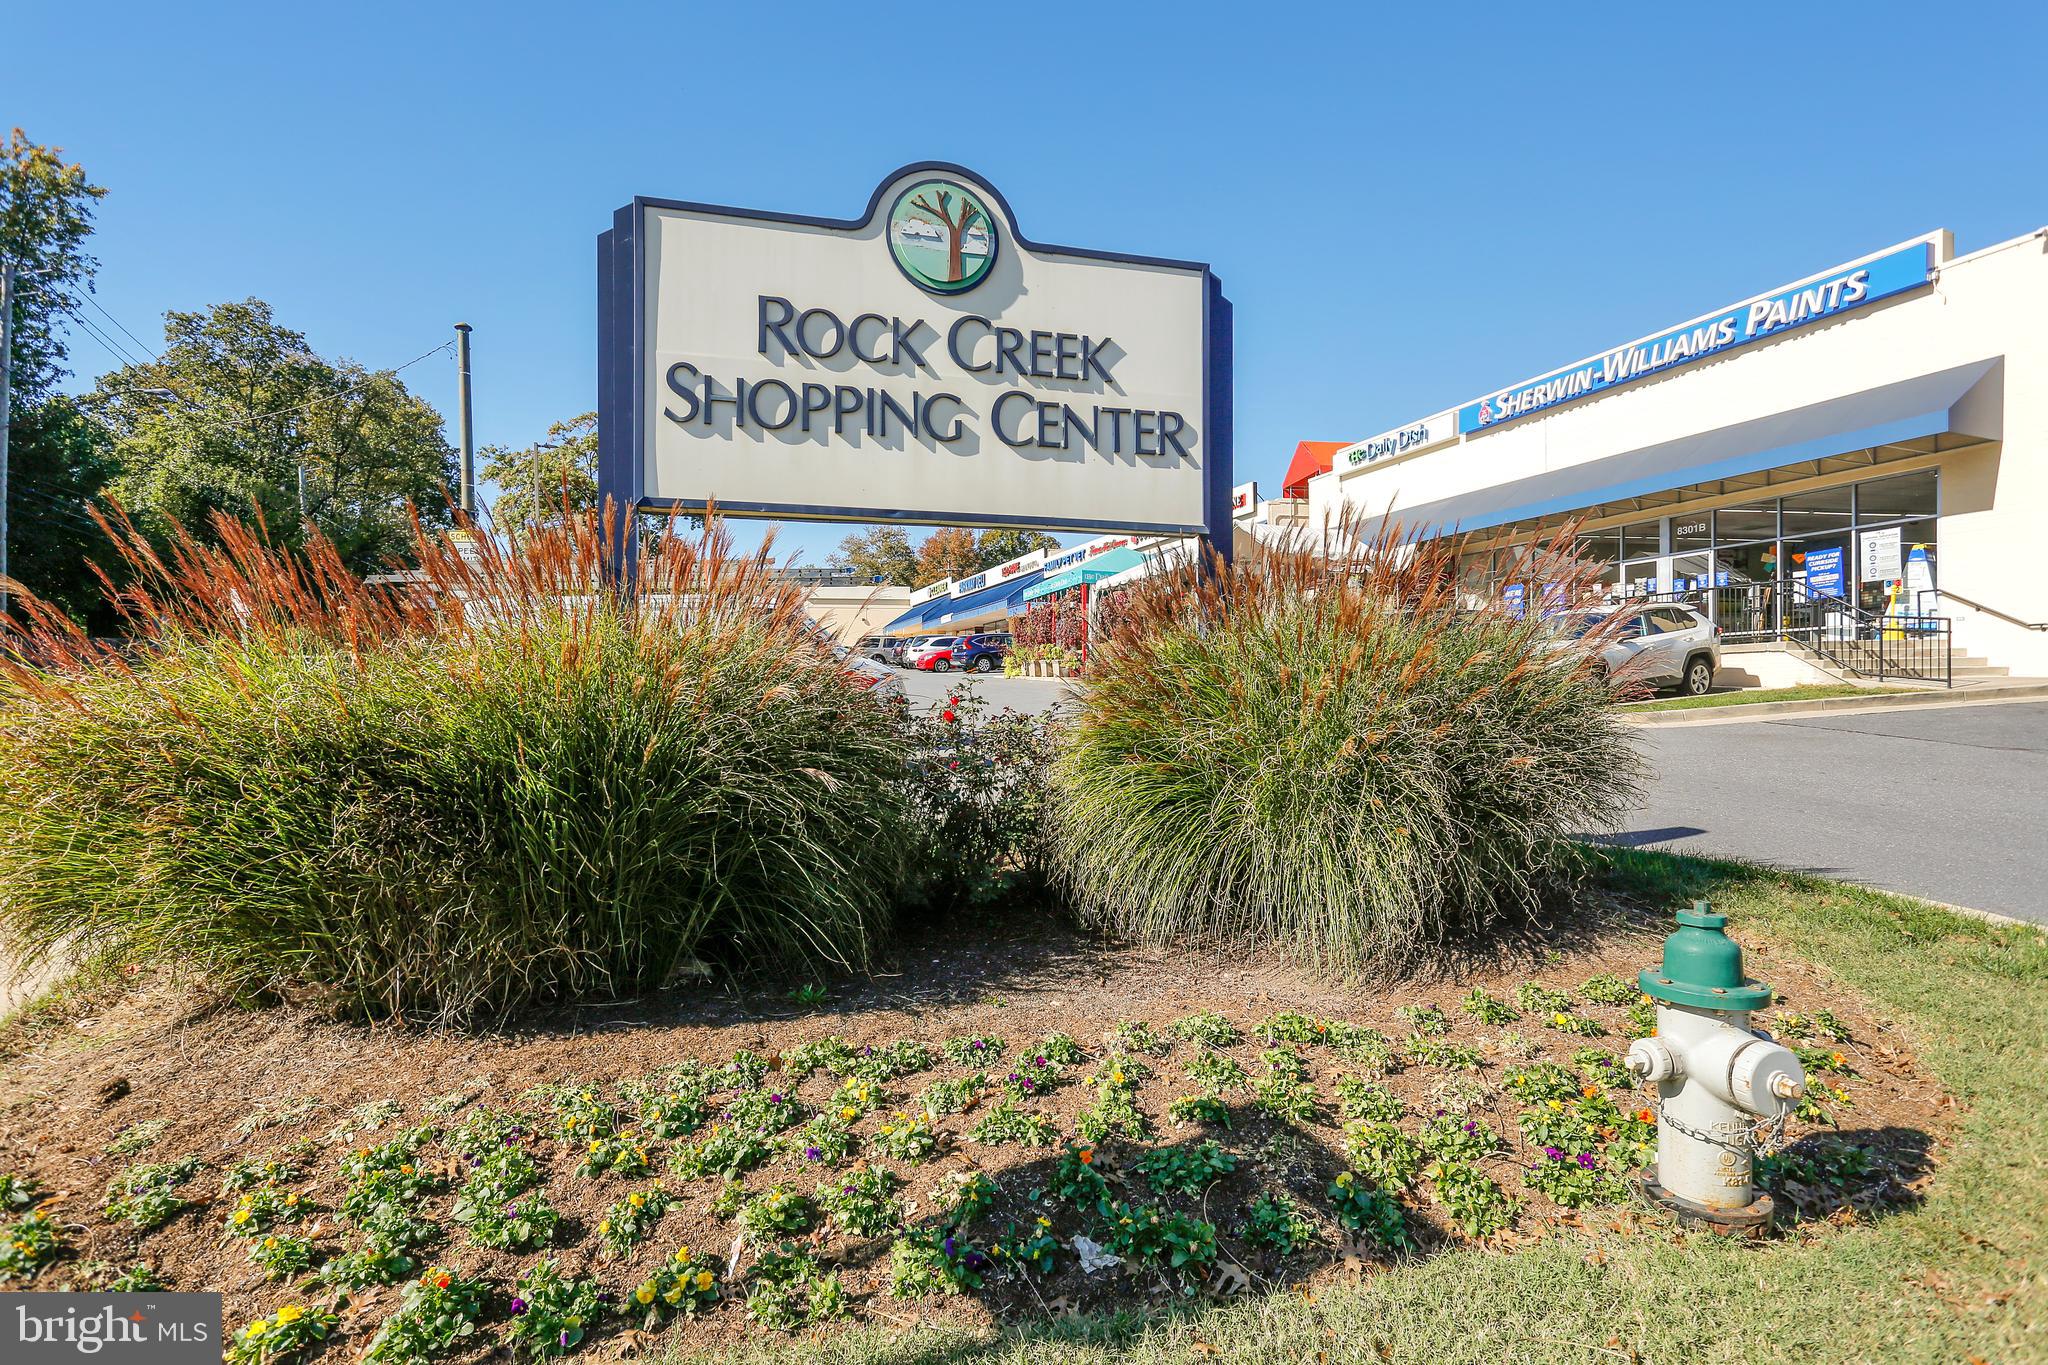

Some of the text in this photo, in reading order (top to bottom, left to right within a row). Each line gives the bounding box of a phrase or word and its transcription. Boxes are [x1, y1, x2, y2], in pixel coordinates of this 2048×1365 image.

[758, 295, 1113, 382] ROCK CREEK
[1493, 270, 1869, 421] SHERWIN-WILLIAMS PAINTS
[663, 361, 1189, 457] SHOPPING CENTER
[1367, 438, 1397, 461] Daily
[1399, 424, 1429, 450] Dish
[1677, 523, 1706, 535] 8301B
